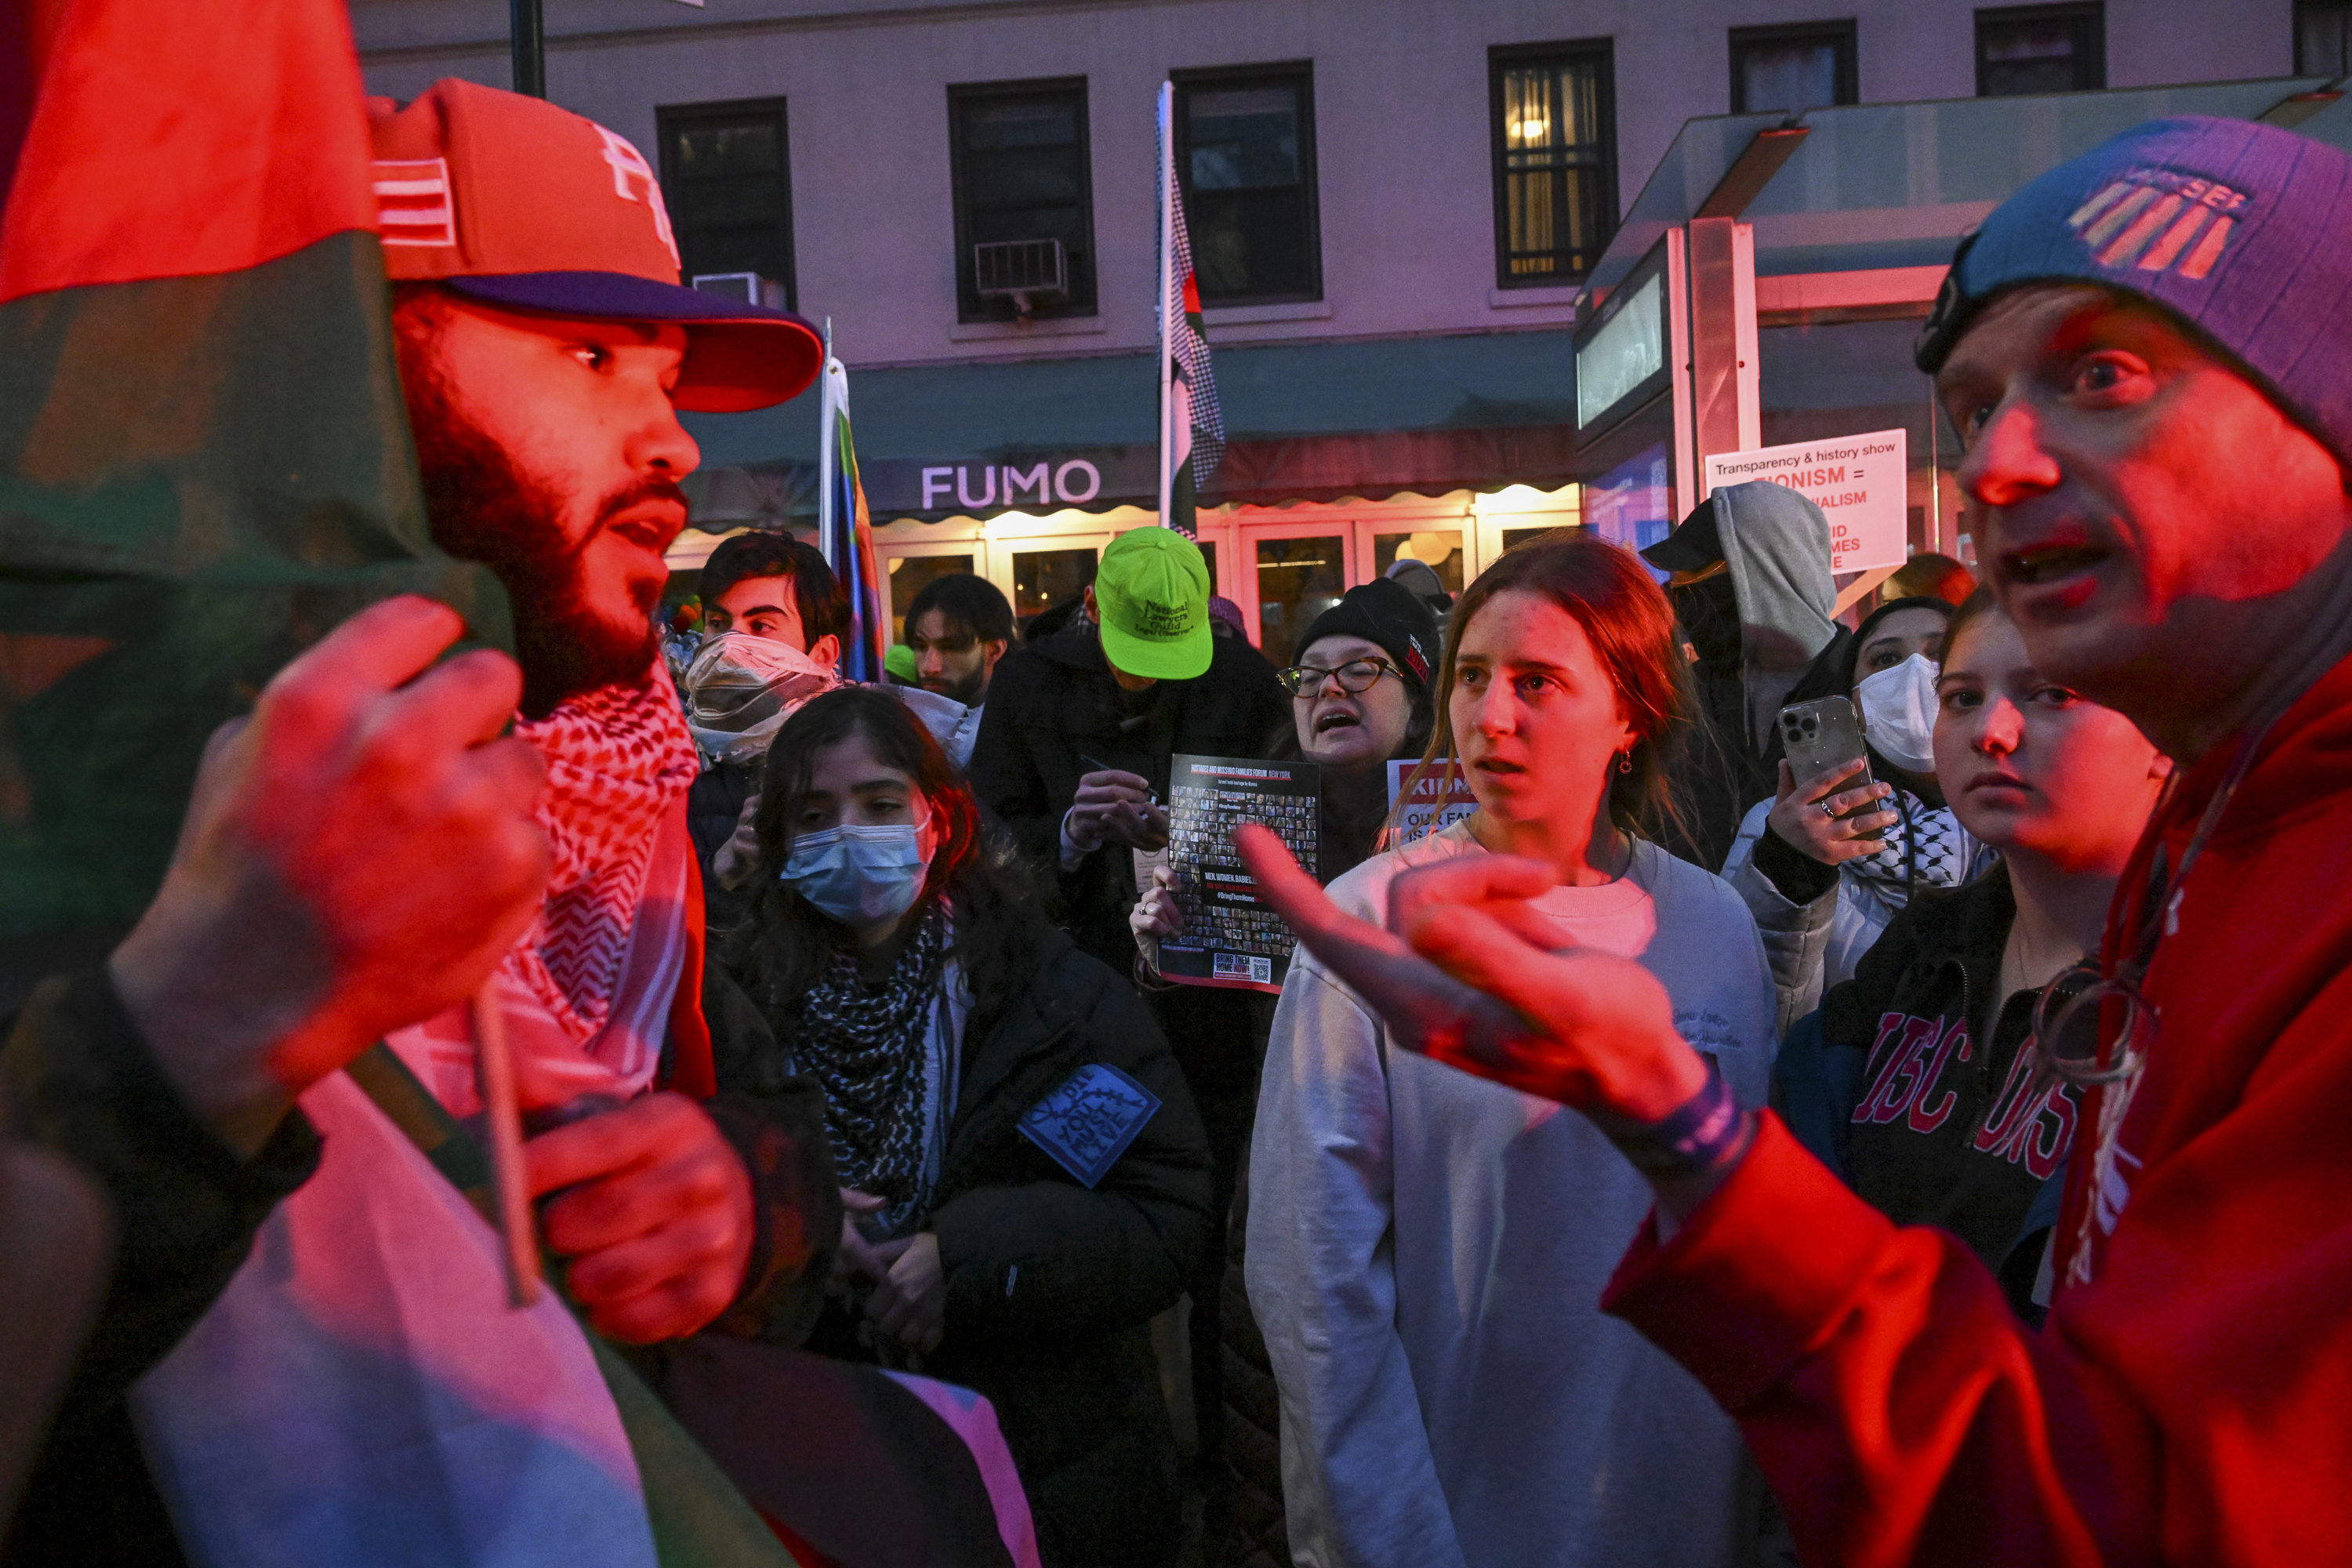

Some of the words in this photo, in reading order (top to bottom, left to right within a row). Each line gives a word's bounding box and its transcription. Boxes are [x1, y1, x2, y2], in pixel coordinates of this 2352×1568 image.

[1716, 455, 1800, 476] Transparency
[1804, 452, 1813, 463] &
[1817, 448, 1859, 463] history
[1862, 443, 1896, 456] show
[922, 459, 1101, 510] FUMO
[1143, 608, 1188, 622] Lawyers
[1145, 599, 1188, 615] National
[1150, 621, 1181, 630] Guild
[1235, 768, 1252, 776] FAMILIES
[1253, 768, 1267, 777] FORUM
[1216, 953, 1233, 964] BRING
[1235, 955, 1250, 965] THEM
[1216, 963, 1233, 972] HOME
[1234, 964, 1250, 974] NOW!
[1057, 1102, 1092, 1144] YOU
[1070, 1102, 1111, 1157] MUST
[1081, 1112, 1131, 1167] LIVE
